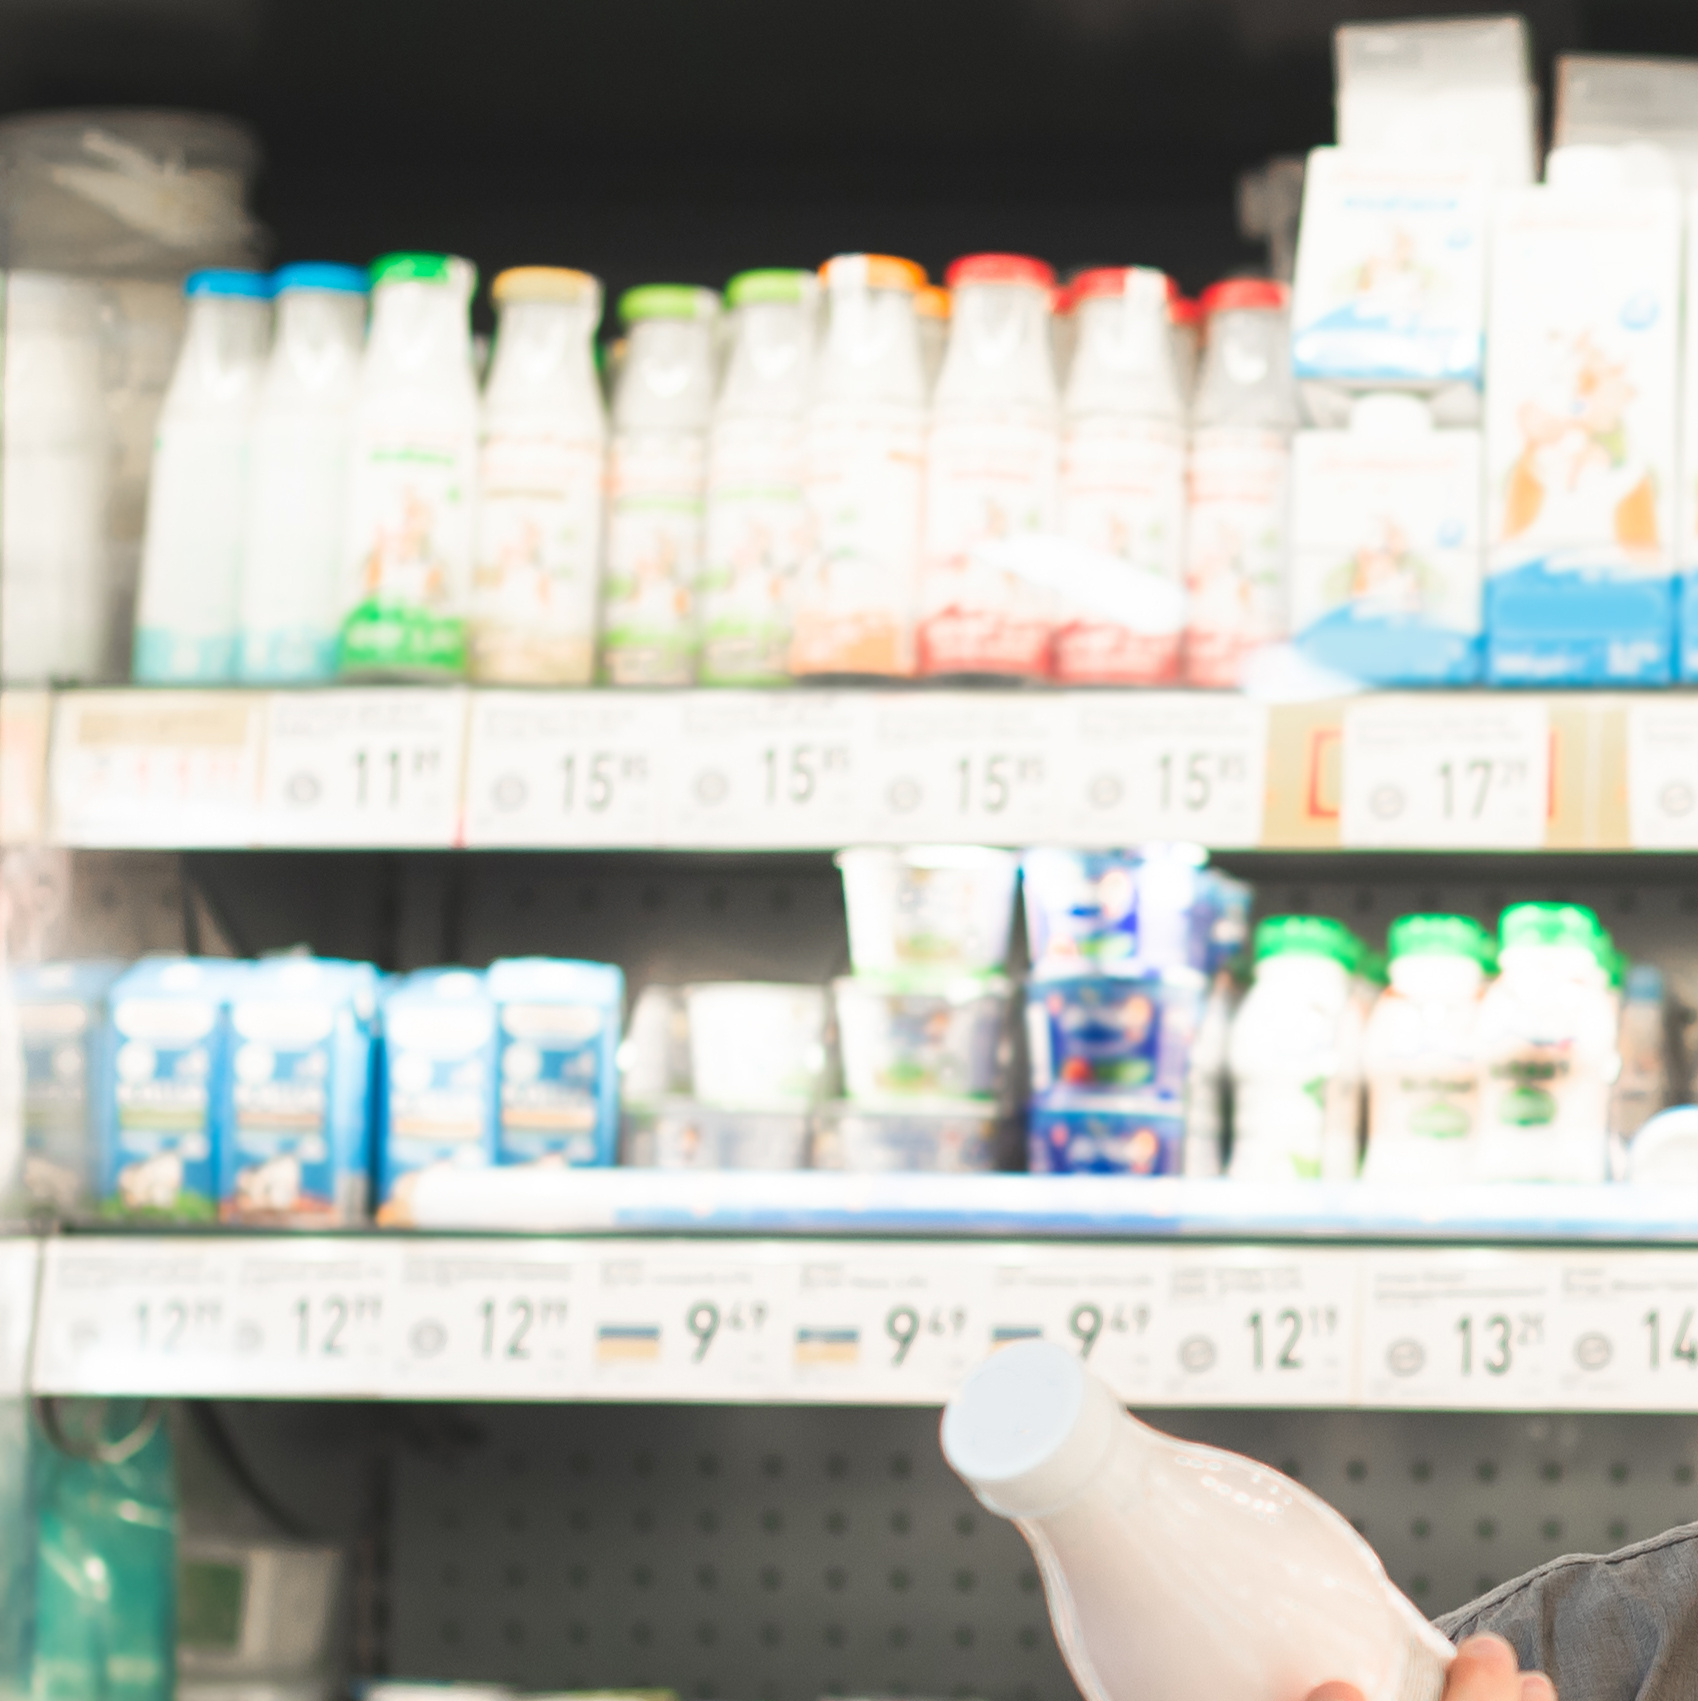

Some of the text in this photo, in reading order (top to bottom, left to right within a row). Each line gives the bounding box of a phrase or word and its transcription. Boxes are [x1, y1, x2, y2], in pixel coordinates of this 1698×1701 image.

[354, 748, 401, 809] 11
[561, 753, 614, 815] 15
[761, 743, 816, 805] 15
[958, 748, 1010, 810] 15
[1156, 749, 1213, 814] 15
[1438, 758, 1493, 821] 17
[135, 1295, 189, 1358] 12
[292, 1295, 348, 1358] 12
[480, 1297, 534, 1360] 12
[685, 1300, 721, 1365] 9
[884, 1304, 920, 1367] 9
[1068, 1302, 1104, 1364] 9
[1245, 1306, 1304, 1372] 12
[1453, 1312, 1512, 1377] 13
